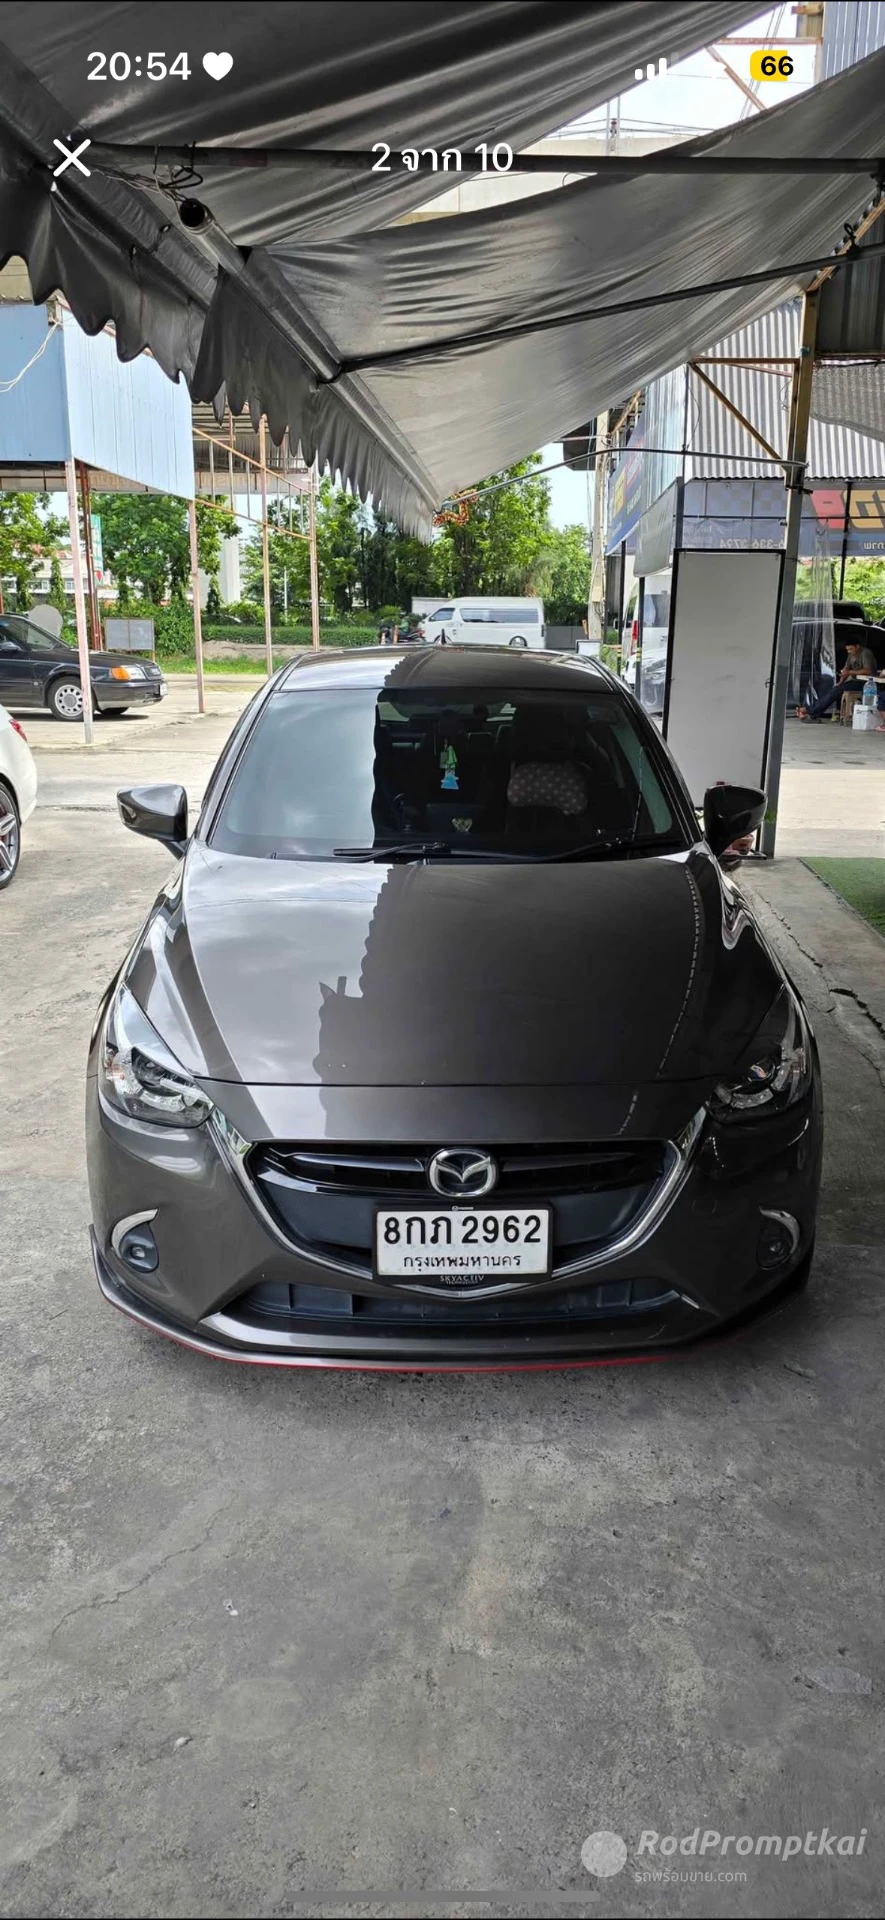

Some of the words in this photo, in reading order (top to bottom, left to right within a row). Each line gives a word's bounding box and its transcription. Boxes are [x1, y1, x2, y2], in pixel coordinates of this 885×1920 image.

[383, 1216, 452, 1245] 8กภ
[461, 1214, 541, 1244] 2962
[403, 1255, 522, 1272] กรุงเทพมหานคร
[439, 1274, 485, 1282] SKYACTIV
